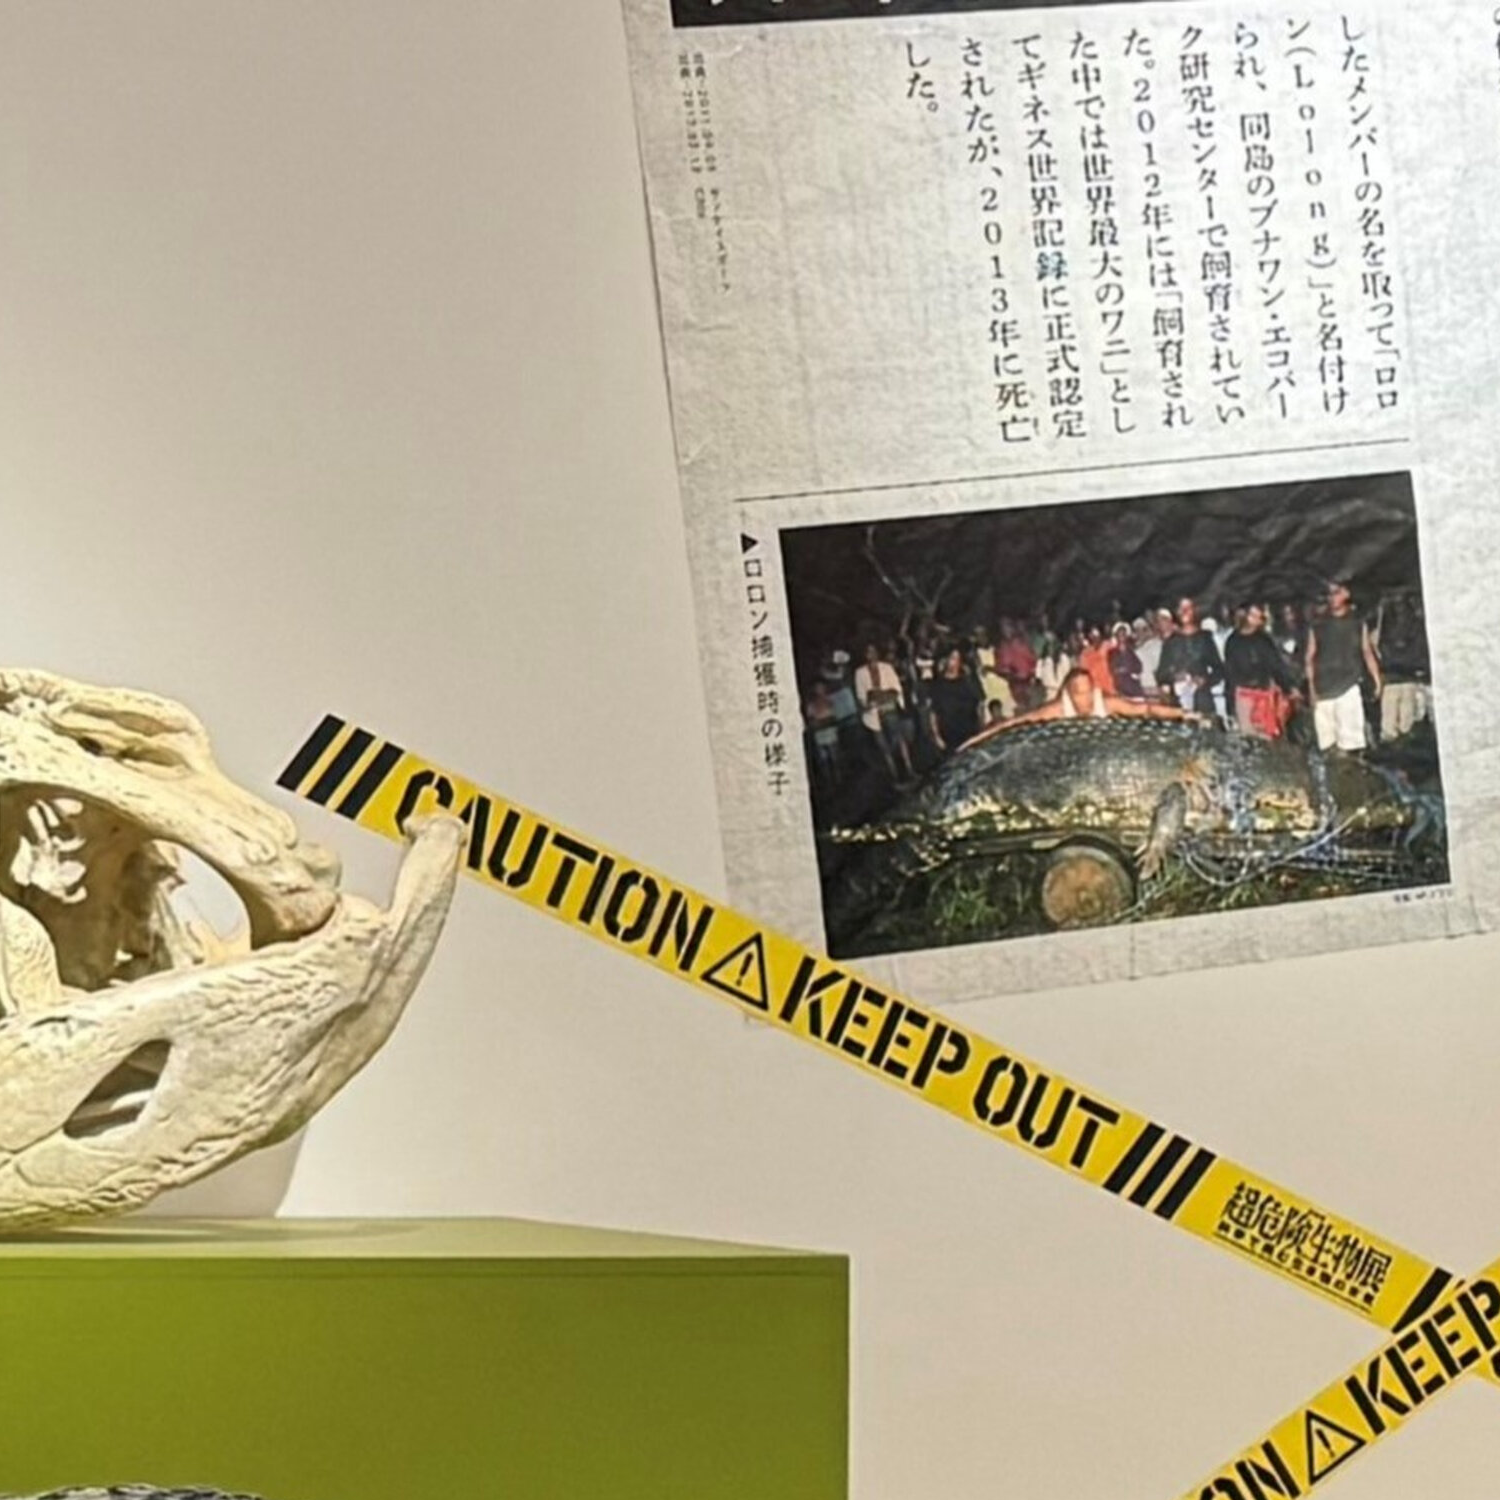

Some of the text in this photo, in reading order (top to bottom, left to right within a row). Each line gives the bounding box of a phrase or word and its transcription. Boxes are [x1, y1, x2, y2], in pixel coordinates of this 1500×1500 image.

[906, 41, 939, 113] した。
[394, 769, 1121, 1170] CAUTION KEEP OUT
[1219, 1181, 1393, 1295] 超危険生物展
[1345, 1279, 1500, 1436] KEEP
